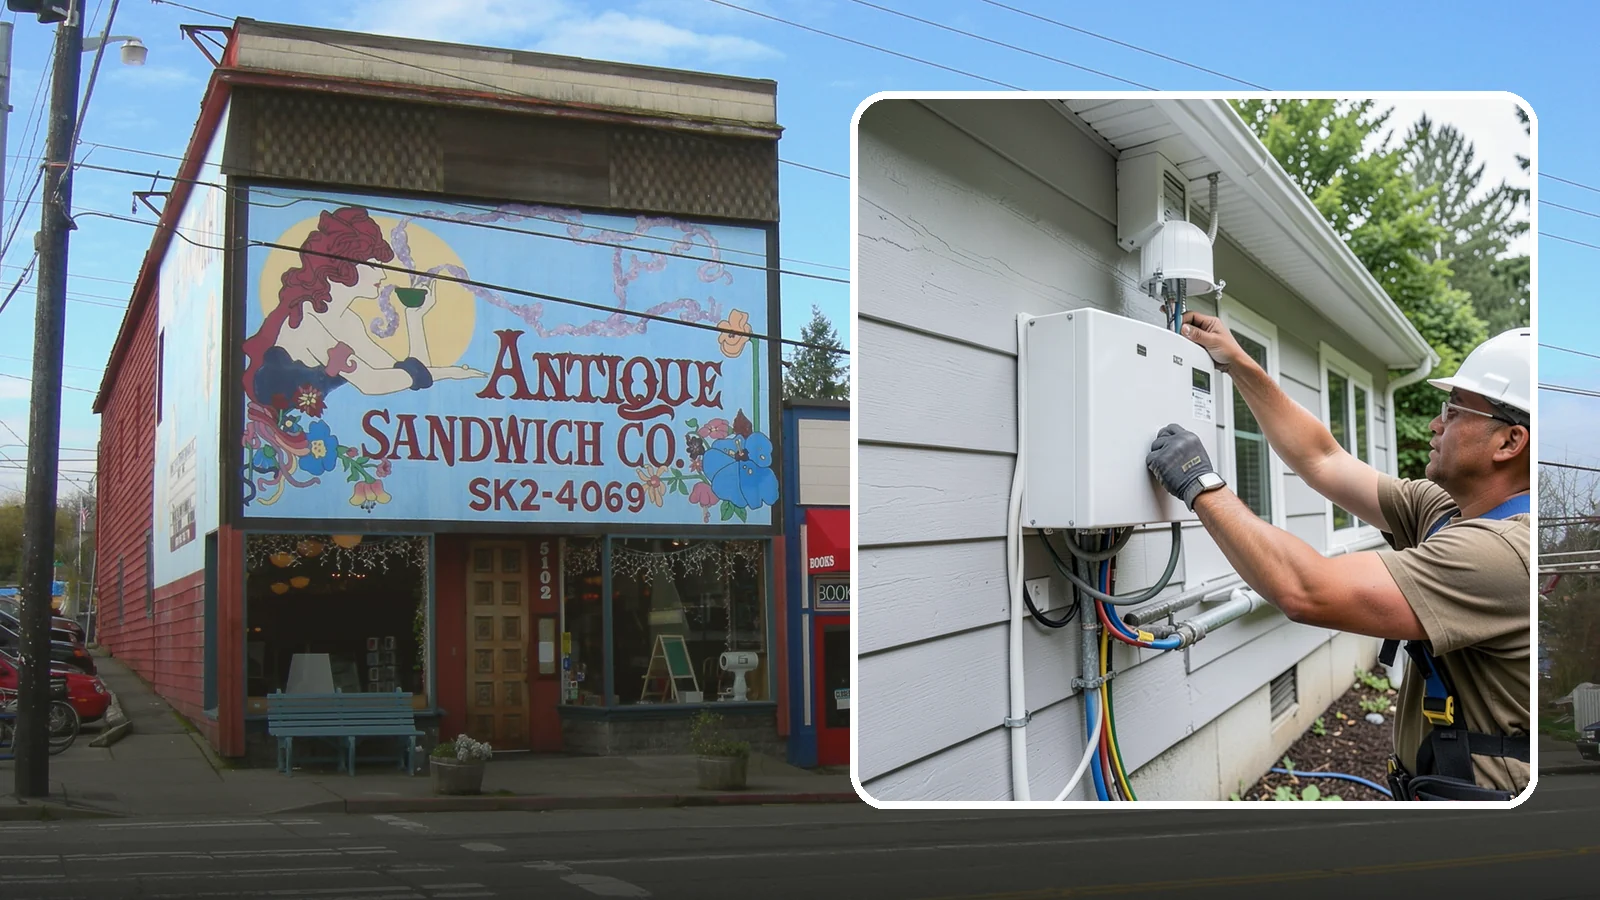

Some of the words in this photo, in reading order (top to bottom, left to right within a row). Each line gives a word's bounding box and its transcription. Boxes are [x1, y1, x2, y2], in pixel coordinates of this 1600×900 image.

[476, 329, 723, 420] ANTIQUE
[361, 408, 604, 467] SANDWICH
[617, 422, 684, 469] CO.
[469, 477, 645, 513] SK2-4069
[540, 542, 551, 599] 5102
[809, 555, 835, 569] BOOKS
